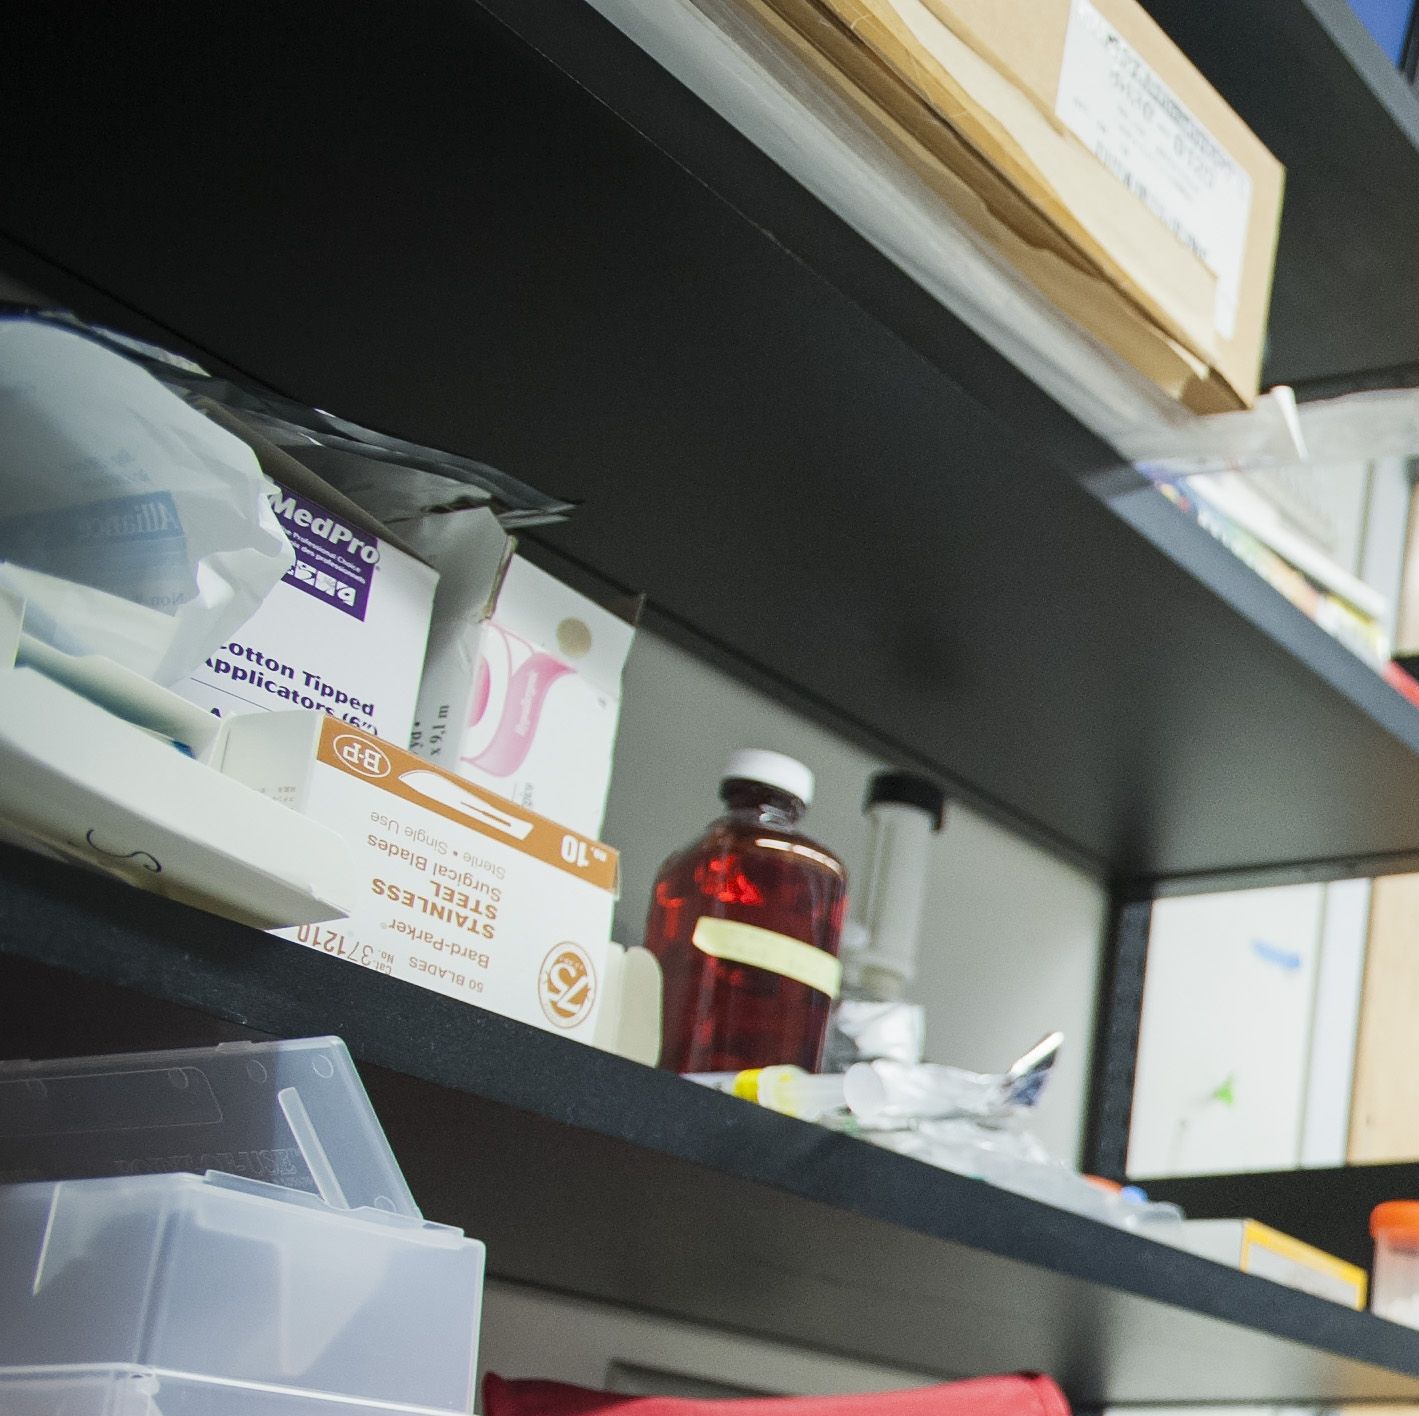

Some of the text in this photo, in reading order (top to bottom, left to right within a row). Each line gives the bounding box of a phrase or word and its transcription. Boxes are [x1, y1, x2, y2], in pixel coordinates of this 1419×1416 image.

[268, 492, 381, 564] MedPro
[220, 642, 375, 717] otton Tipped
[438, 704, 449, 719] m
[367, 834, 500, 902] Surgical Blades
[370, 811, 506, 880] Sterile Single Use
[561, 835, 590, 867] 10
[371, 878, 495, 940] STAINLESS
[430, 880, 498, 920] STEEL
[297, 923, 373, 967] 371210
[408, 956, 484, 993] 50 BLADES
